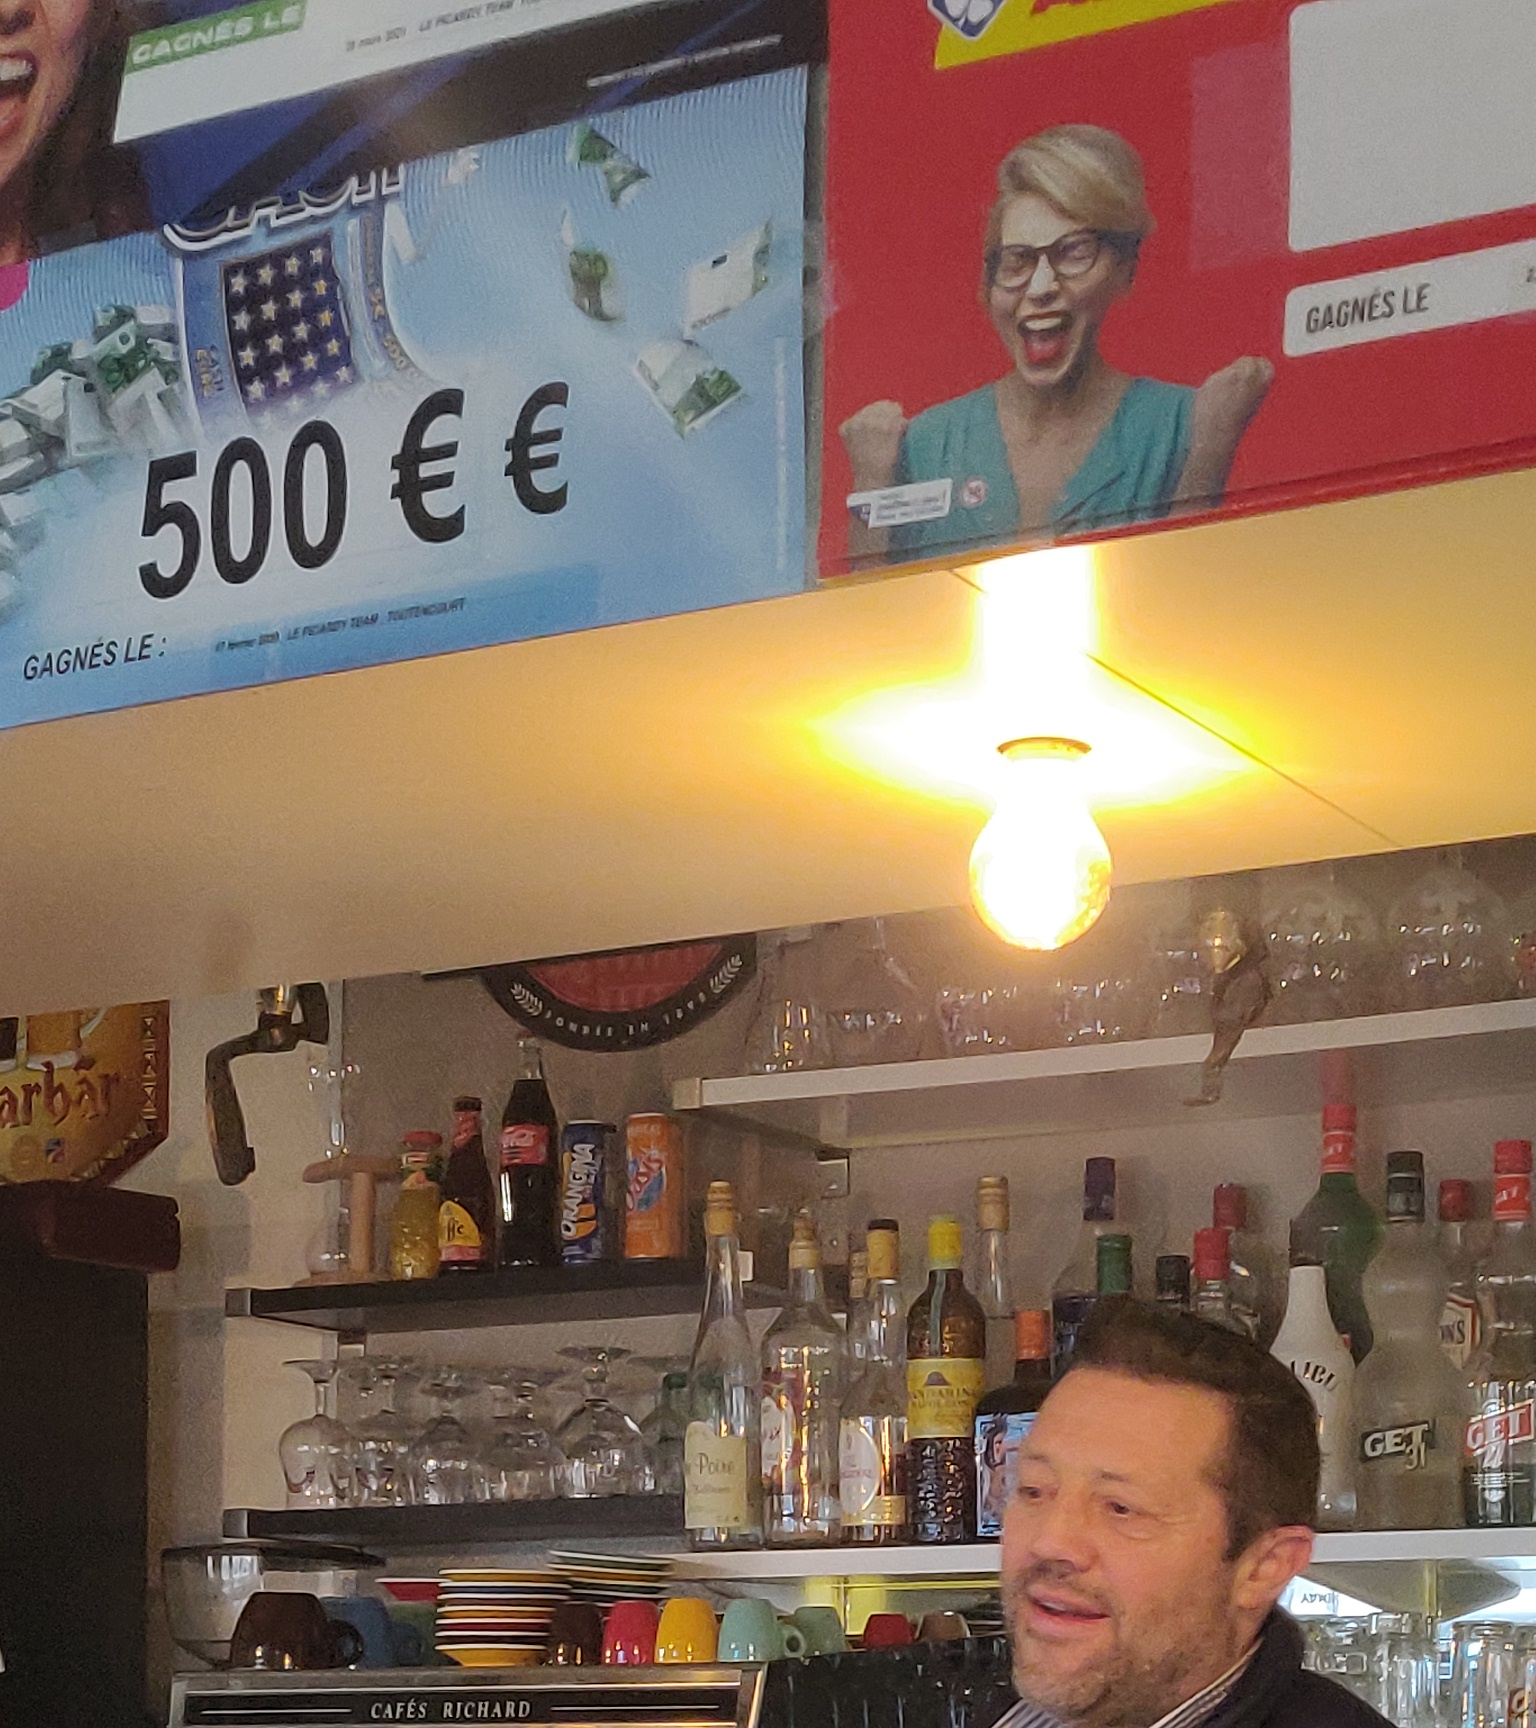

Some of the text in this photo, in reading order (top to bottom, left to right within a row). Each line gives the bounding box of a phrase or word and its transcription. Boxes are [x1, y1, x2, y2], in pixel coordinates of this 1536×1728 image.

[1305, 283, 1430, 334] GAGNÉS LE
[138, 381, 570, 600] 500 € €
[23, 637, 117, 683] GAGNÉS
[121, 635, 155, 666] LE
[560, 1143, 596, 1239] ORANGINA
[1364, 1423, 1430, 1457] GET
[1466, 1407, 1529, 1452] GET
[371, 1698, 531, 1719] CAFÉS RICHARD
